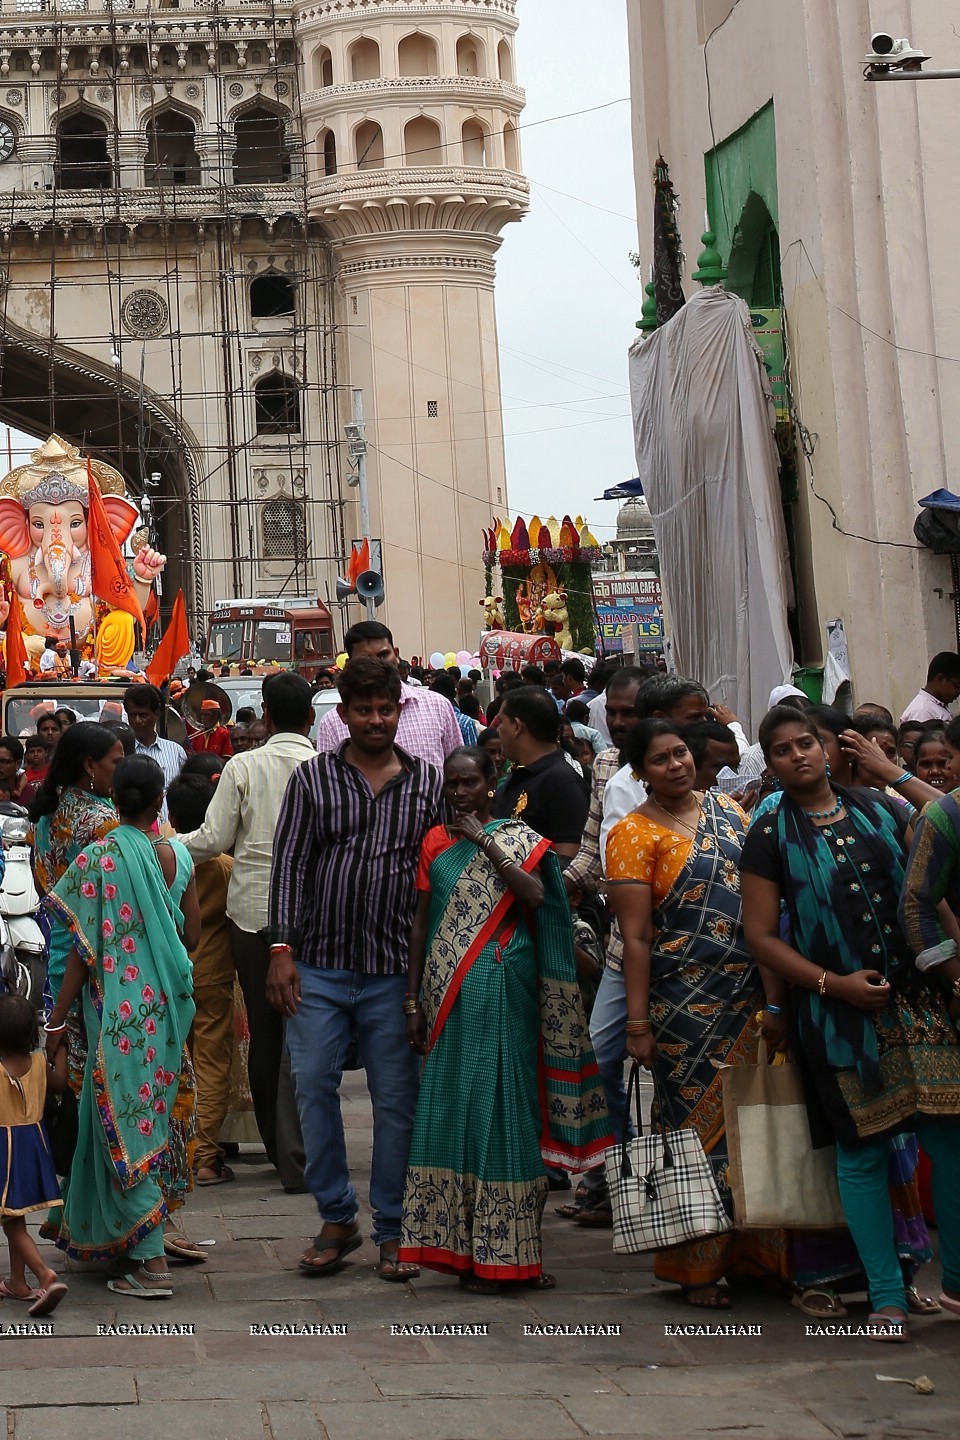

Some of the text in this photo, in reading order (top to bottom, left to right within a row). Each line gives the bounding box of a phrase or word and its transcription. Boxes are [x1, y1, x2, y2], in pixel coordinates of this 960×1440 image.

[611, 582, 640, 595] FARASHA
[640, 581, 656, 594] CAFE
[598, 613, 654, 623] SHAADAN
